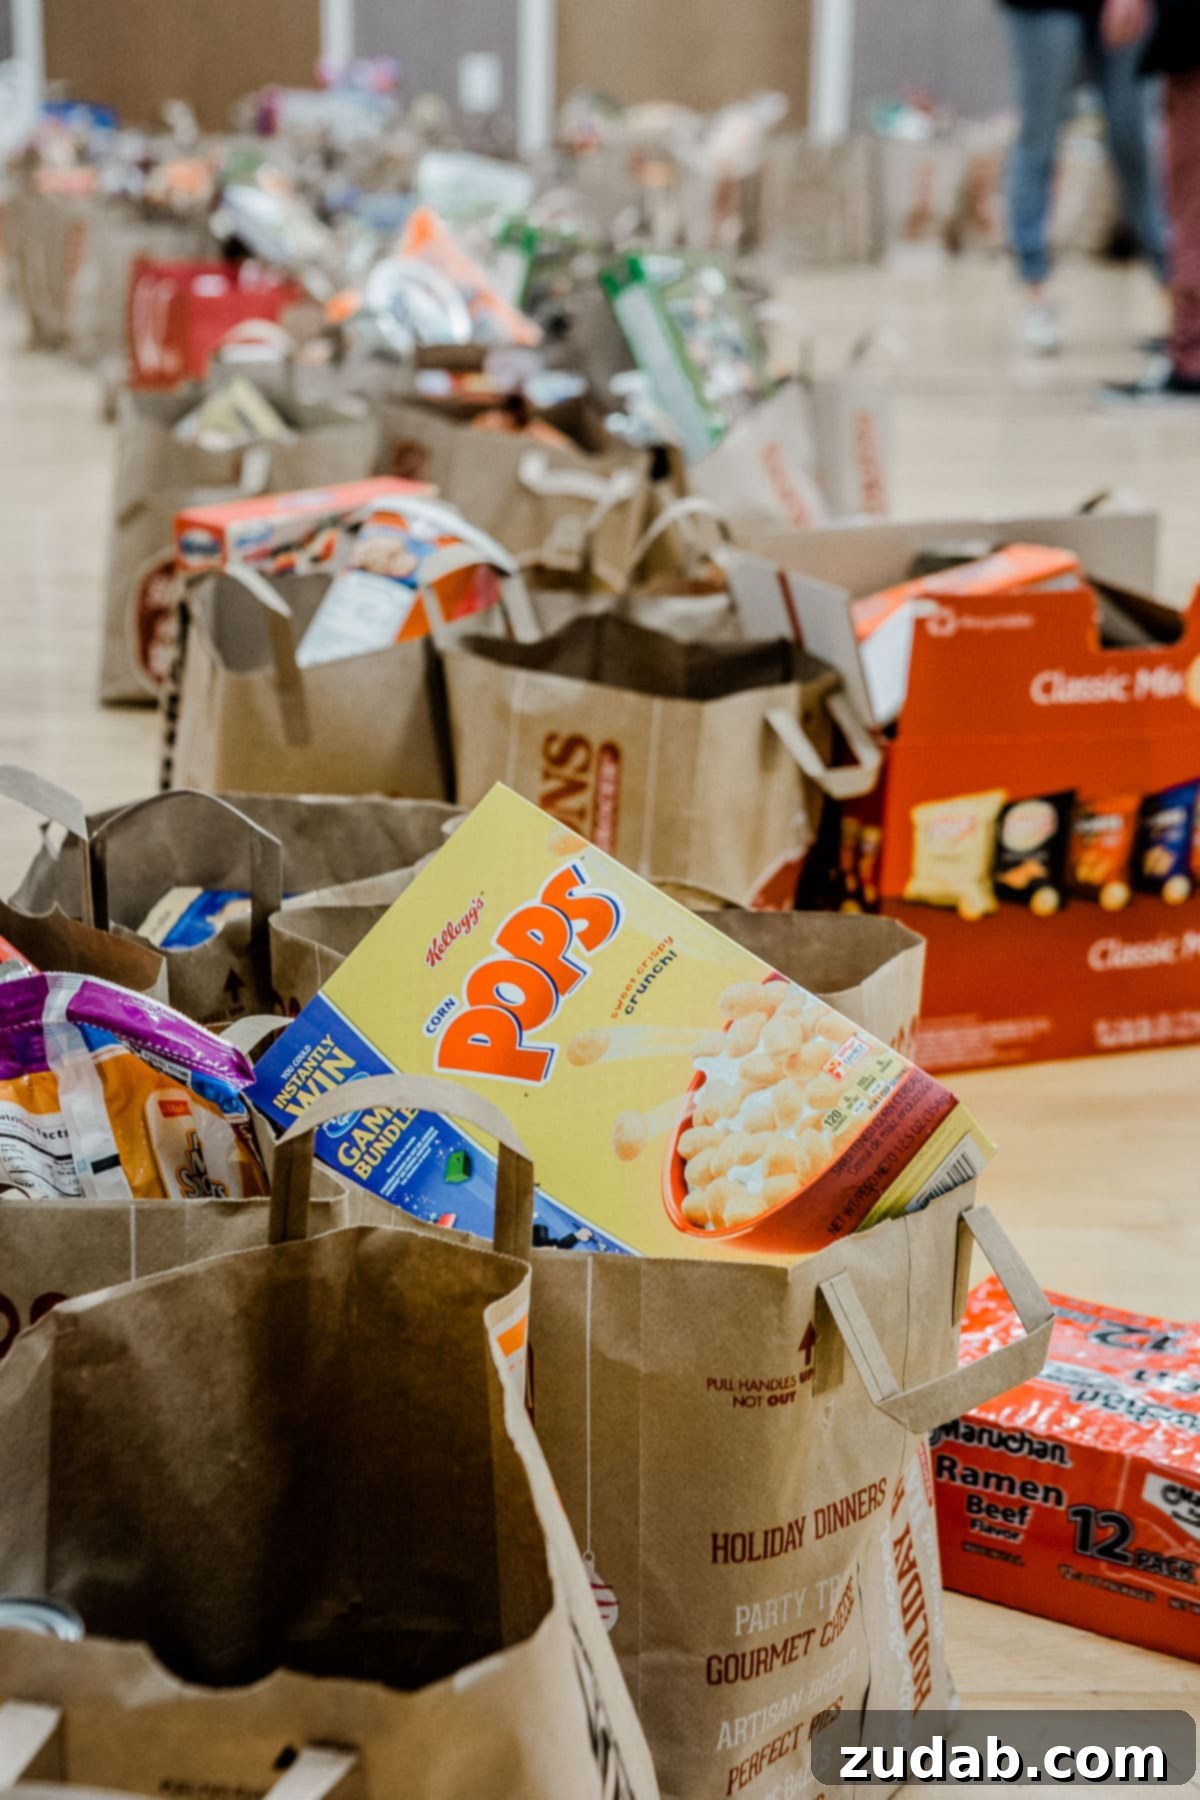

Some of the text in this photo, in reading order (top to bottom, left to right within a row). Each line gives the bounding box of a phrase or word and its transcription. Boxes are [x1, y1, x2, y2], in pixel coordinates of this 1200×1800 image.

[1030, 667, 1184, 705] Classic Mix
[426, 897, 484, 967] Kellogg's
[1087, 937, 1177, 971] Classic
[435, 861, 623, 1085] POPS
[611, 935, 674, 1019] sweet crispy
[624, 950, 678, 1015] crunch!
[426, 998, 456, 1034] CORN
[273, 1034, 335, 1109] INSTANTLY
[281, 1045, 311, 1079] YOU COULD
[338, 1106, 399, 1167] GAM
[824, 1109, 842, 1127] 120
[872, 1102, 897, 1130] CORN
[870, 1137, 882, 1152] de
[827, 1211, 845, 1235] NET
[874, 1152, 898, 1180] NETO
[910, 1119, 925, 1137] OZ
[706, 1377, 735, 1392] PULL
[738, 1374, 797, 1392] HANDLES
[732, 1391, 796, 1409] NOT OUT
[940, 1418, 1070, 1466] Maruchan
[935, 1453, 1065, 1509] Ramen
[711, 1515, 807, 1565] HOLIDAY
[813, 1477, 888, 1541] DINNERS
[966, 1494, 1030, 1527] Beef
[969, 1518, 1022, 1543] Flavor
[1069, 1506, 1133, 1565] 12
[1134, 1549, 1197, 1584] PACK
[735, 1587, 807, 1637] PARTY
[892, 1522, 933, 1720] HOLIDAY
[706, 1628, 816, 1687] GOURMET
[716, 1689, 804, 1752] ARTISAN
[725, 1723, 805, 1798] PERFECT
